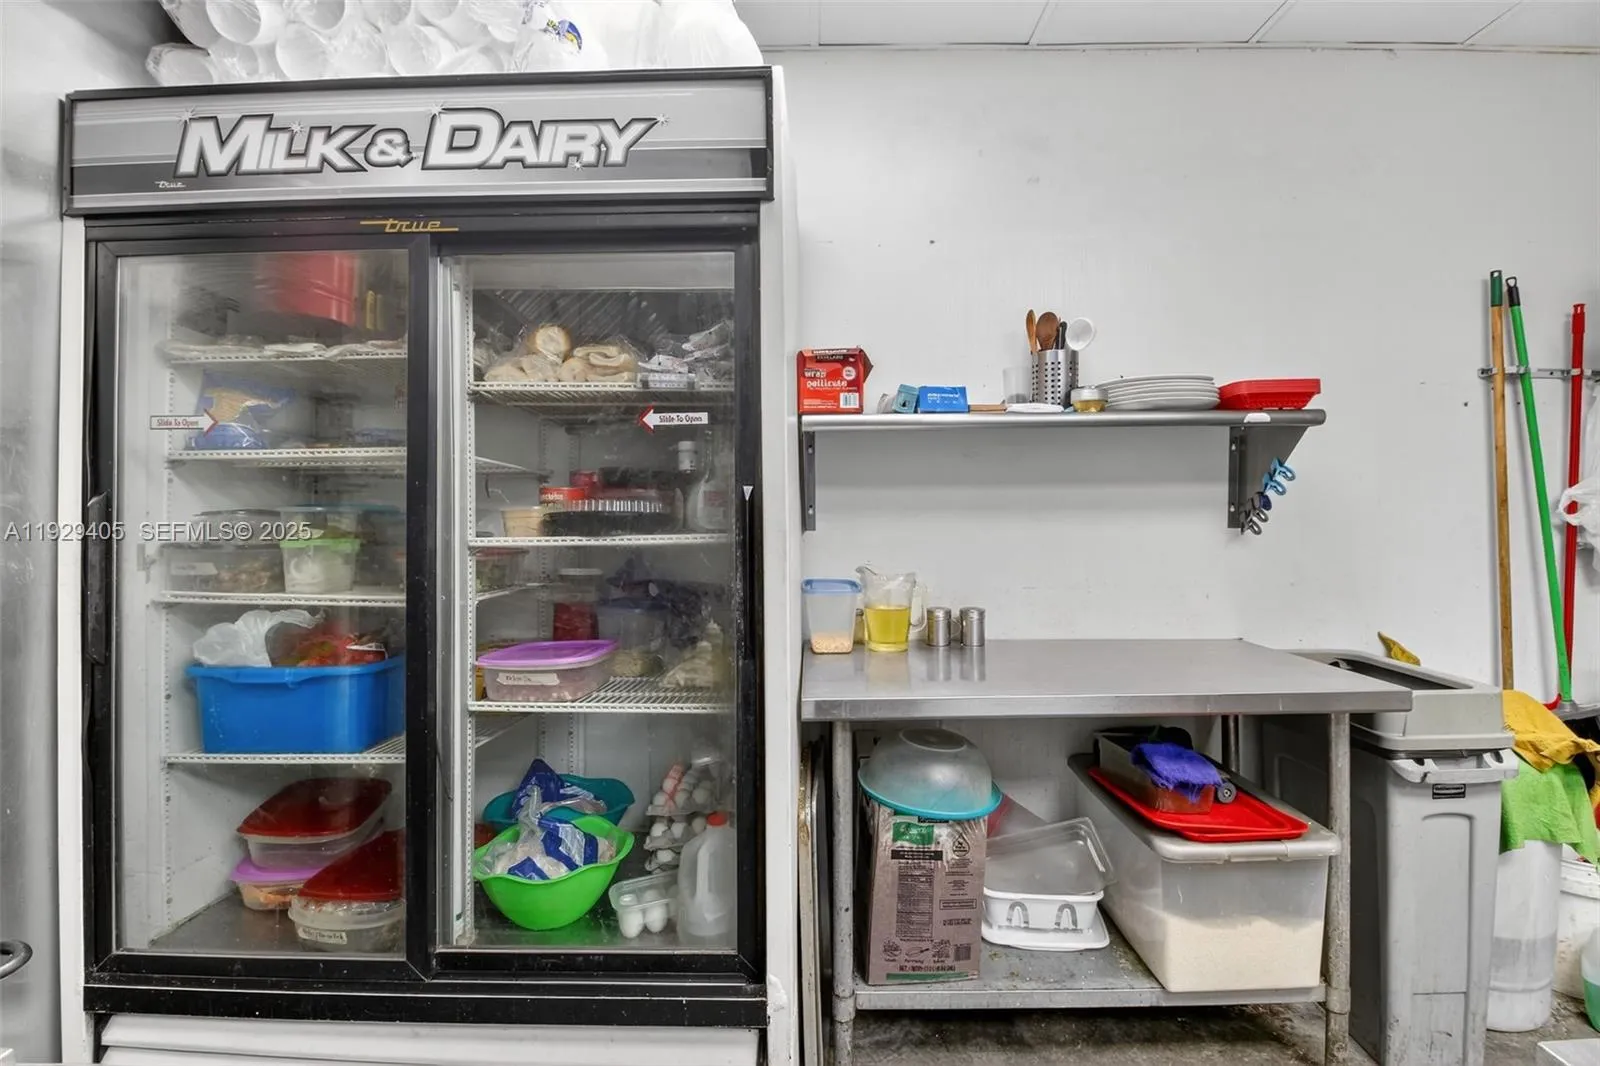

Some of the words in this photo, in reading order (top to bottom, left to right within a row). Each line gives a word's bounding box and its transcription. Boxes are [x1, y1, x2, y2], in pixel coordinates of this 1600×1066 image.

[174, 113, 376, 178] MILK
[364, 128, 414, 168] &
[421, 107, 659, 170] DAIRY
[360, 218, 459, 233] true
[659, 415, 676, 423] Slide
[685, 414, 703, 423] Open
